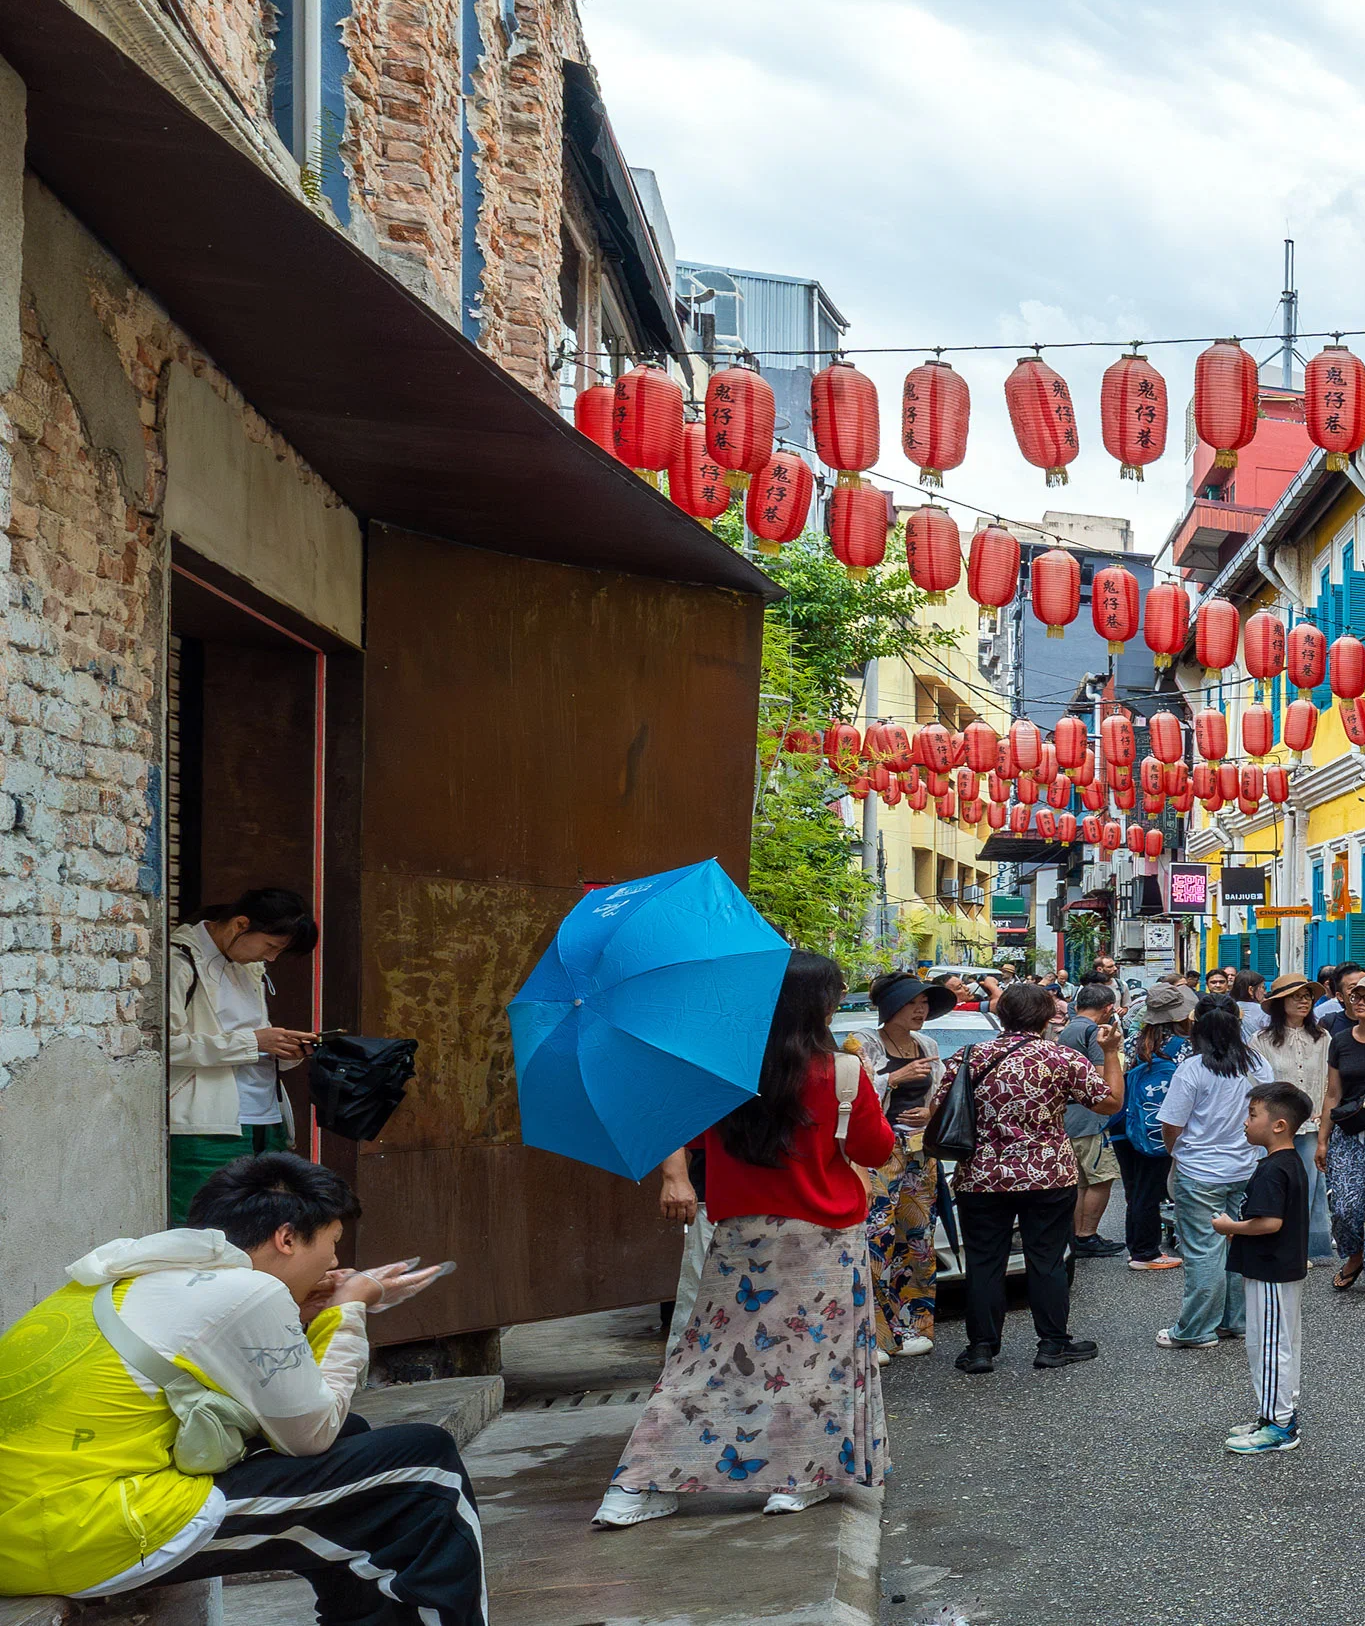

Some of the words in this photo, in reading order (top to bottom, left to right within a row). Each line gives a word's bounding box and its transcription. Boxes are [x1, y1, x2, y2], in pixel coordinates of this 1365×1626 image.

[711, 382, 737, 451] 鬼仔巷
[1053, 380, 1080, 449] 鬼仔巷
[1134, 378, 1160, 449] 鬼仔巷
[1323, 366, 1348, 435] 鬼仔巷
[700, 443, 723, 504] 仔巷
[761, 463, 792, 524] 鬼仔巷
[1103, 579, 1124, 629] 鬼仔巷
[1302, 634, 1317, 677] 鬼仔巷
[1172, 874, 1206, 885] CON
[1172, 884, 1206, 894] CUB
[71, 1428, 96, 1451] P
